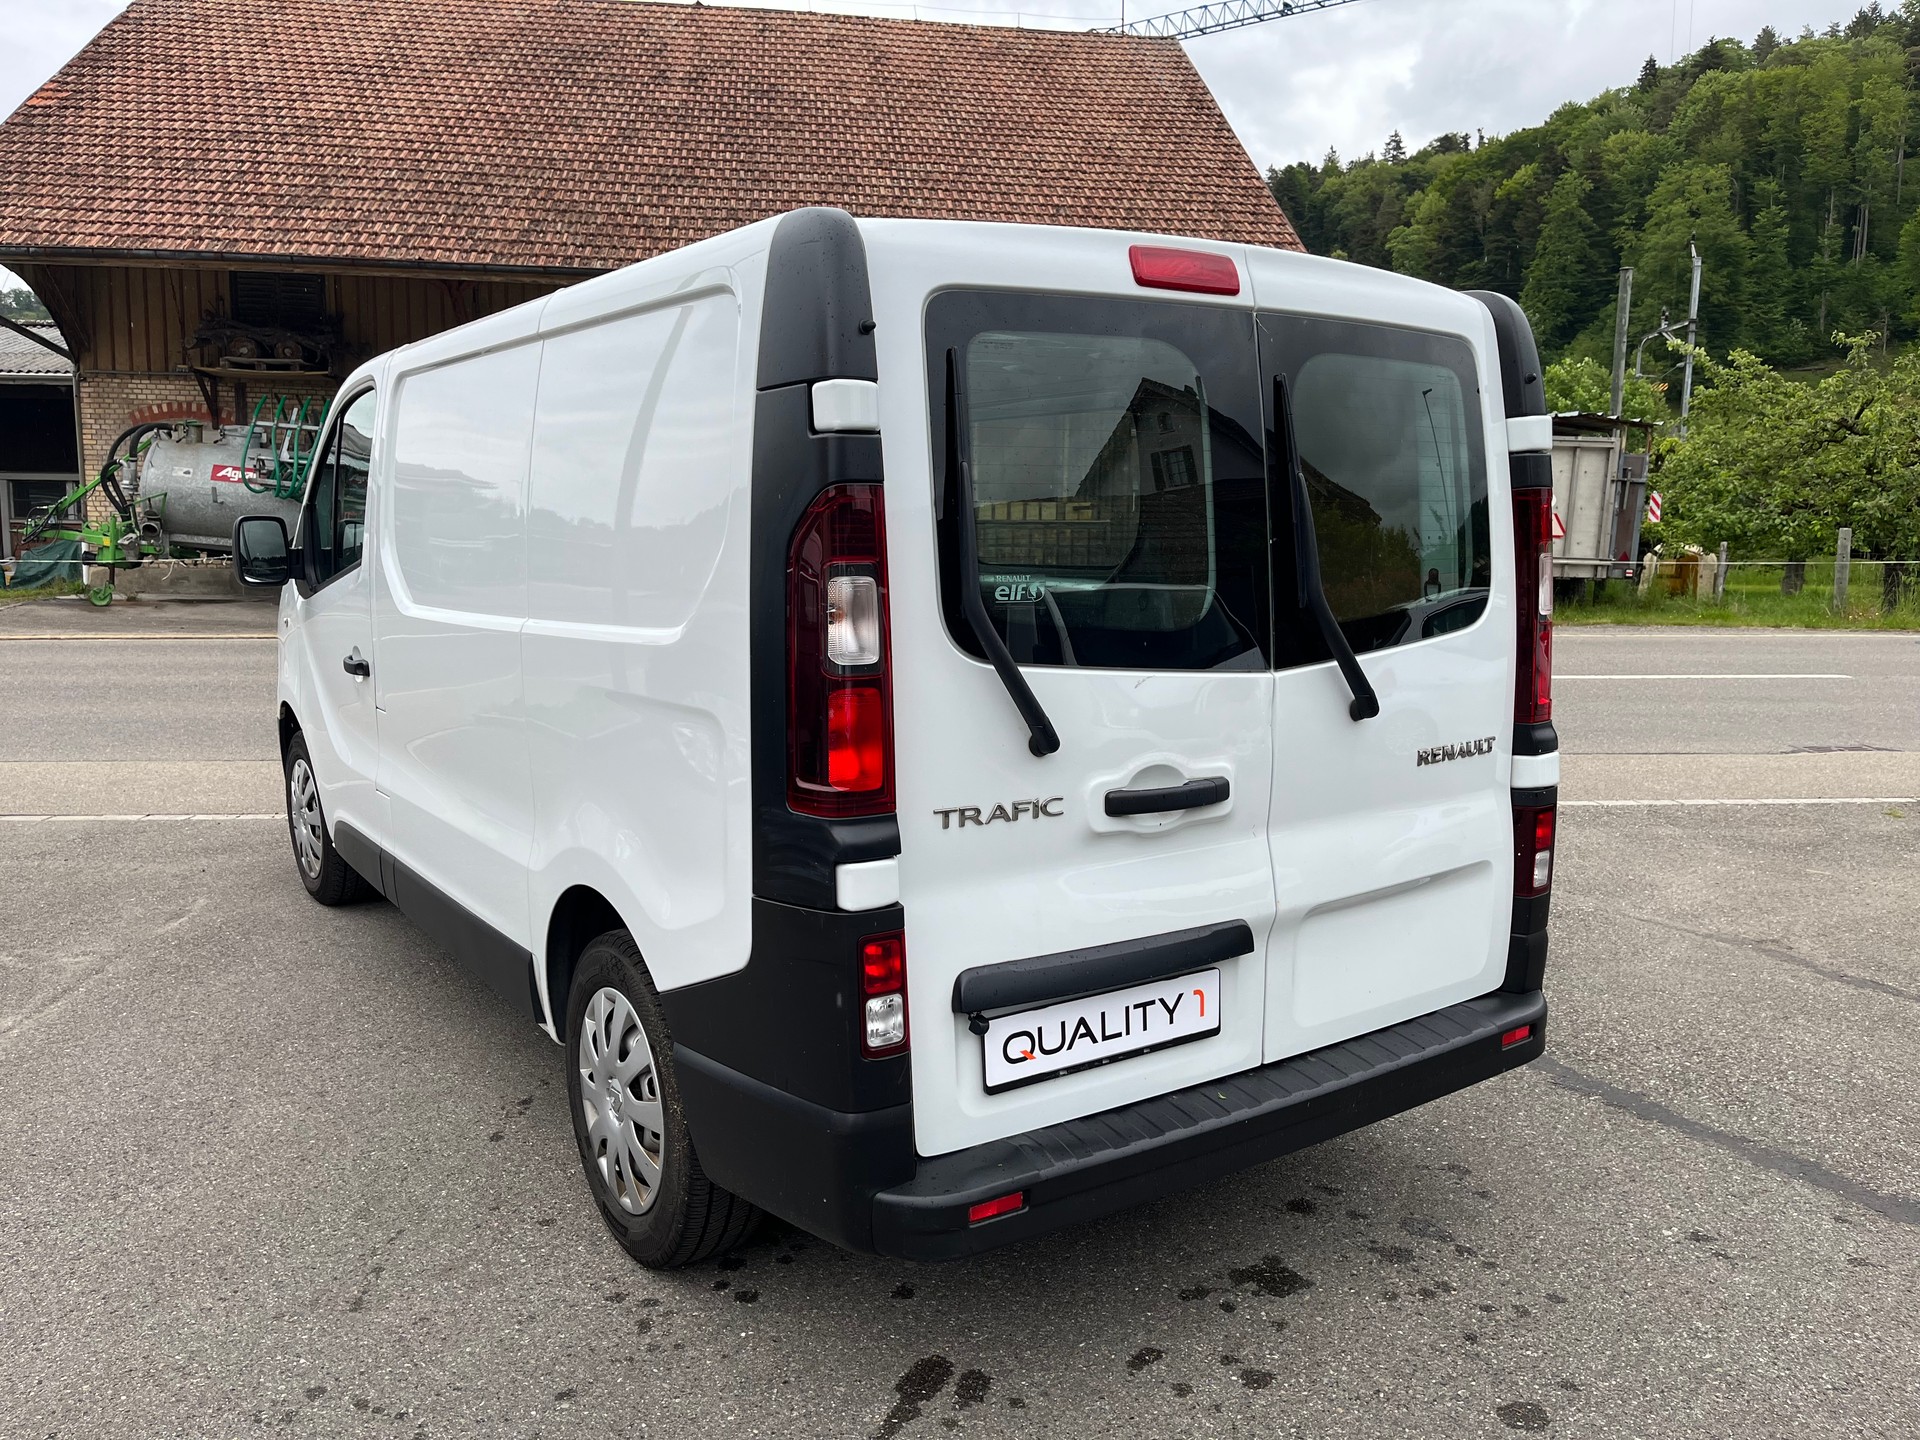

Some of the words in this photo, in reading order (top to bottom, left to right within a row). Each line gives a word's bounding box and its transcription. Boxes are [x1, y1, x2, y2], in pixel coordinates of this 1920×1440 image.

[995, 574, 1031, 582] RENAULT
[995, 583, 1026, 600] elf
[1416, 736, 1496, 767] RENAULT
[933, 796, 1064, 829] TRAFIC
[1002, 992, 1184, 1065] QUALITY
